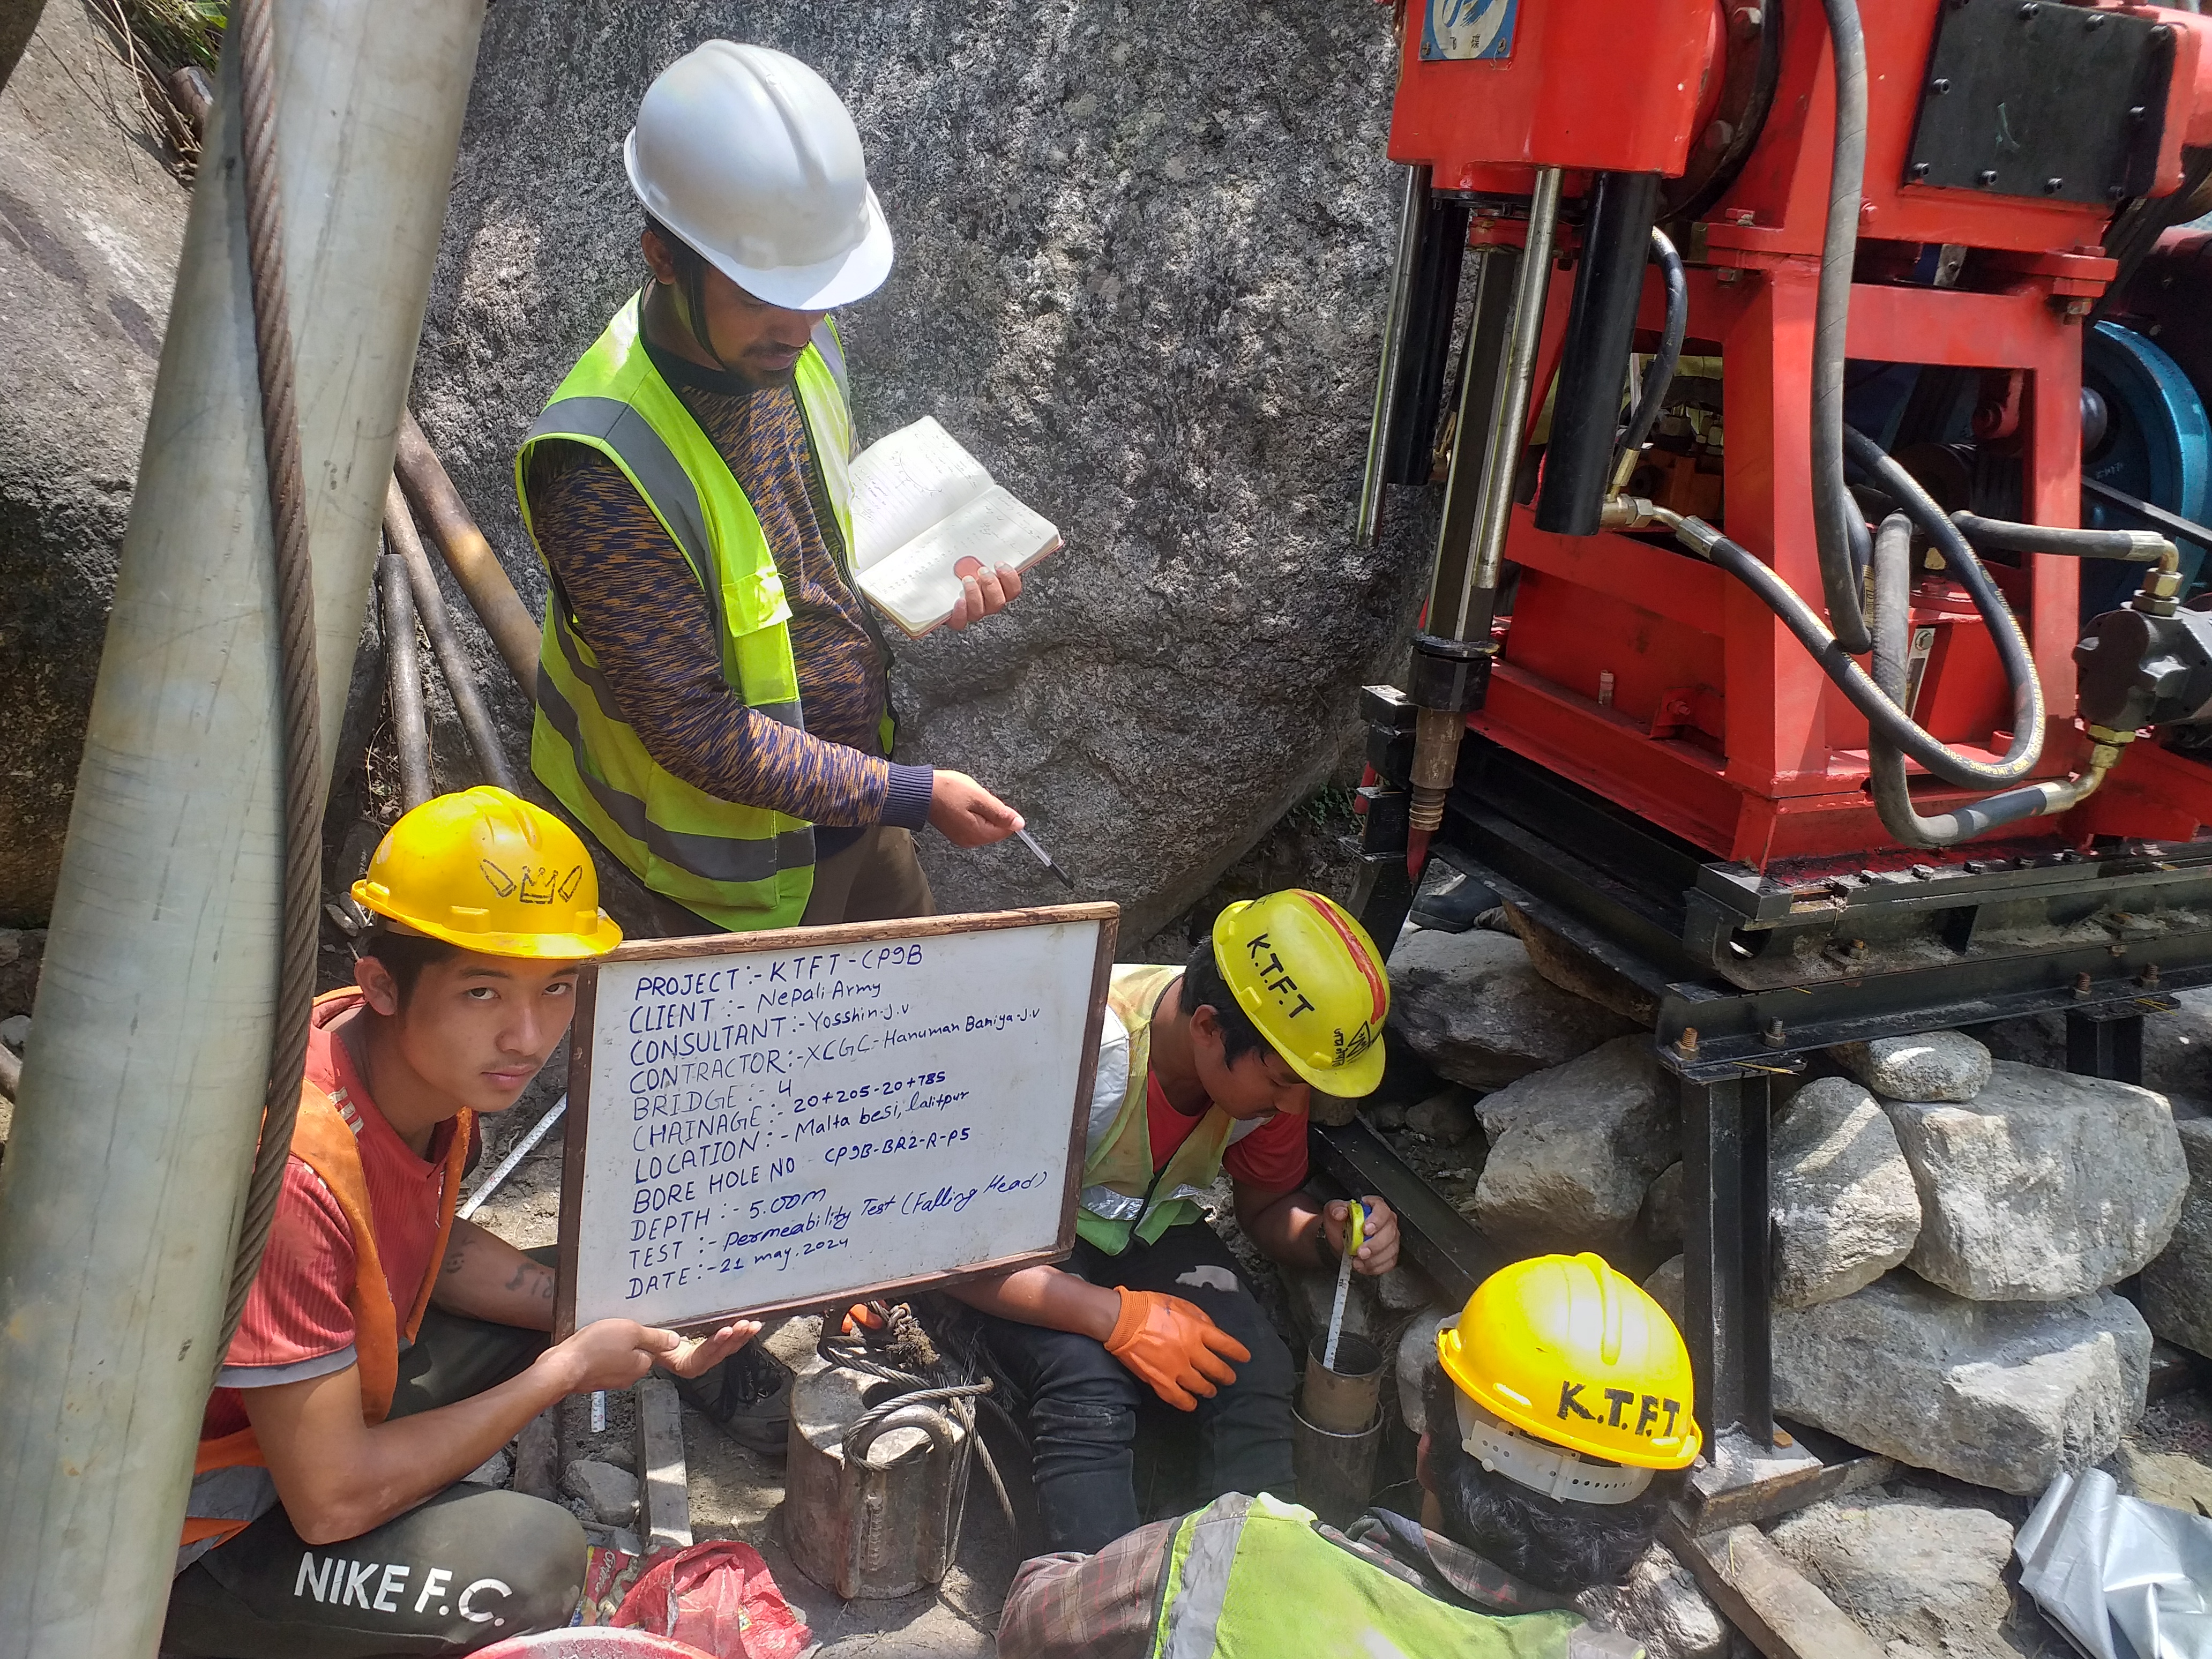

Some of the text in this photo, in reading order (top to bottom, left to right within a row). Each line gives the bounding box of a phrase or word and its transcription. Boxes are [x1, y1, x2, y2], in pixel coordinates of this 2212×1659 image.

[757, 982, 825, 1014] Nepali
[832, 980, 881, 998] Army
[1247, 933, 1315, 1018] K.T.F.T
[778, 1078, 792, 1097] 4
[794, 1114, 851, 1144] Malta
[632, 1180, 696, 1214] BORE
[708, 1165, 760, 1195] HOLE
[769, 1157, 795, 1183] NO
[749, 1188, 827, 1220] 5.00m
[860, 1194, 897, 1216] Test
[982, 1170, 1048, 1194] Head)
[1556, 1380, 1680, 1437] K.T.F.T
[294, 1552, 513, 1627] NIKE F.C.
